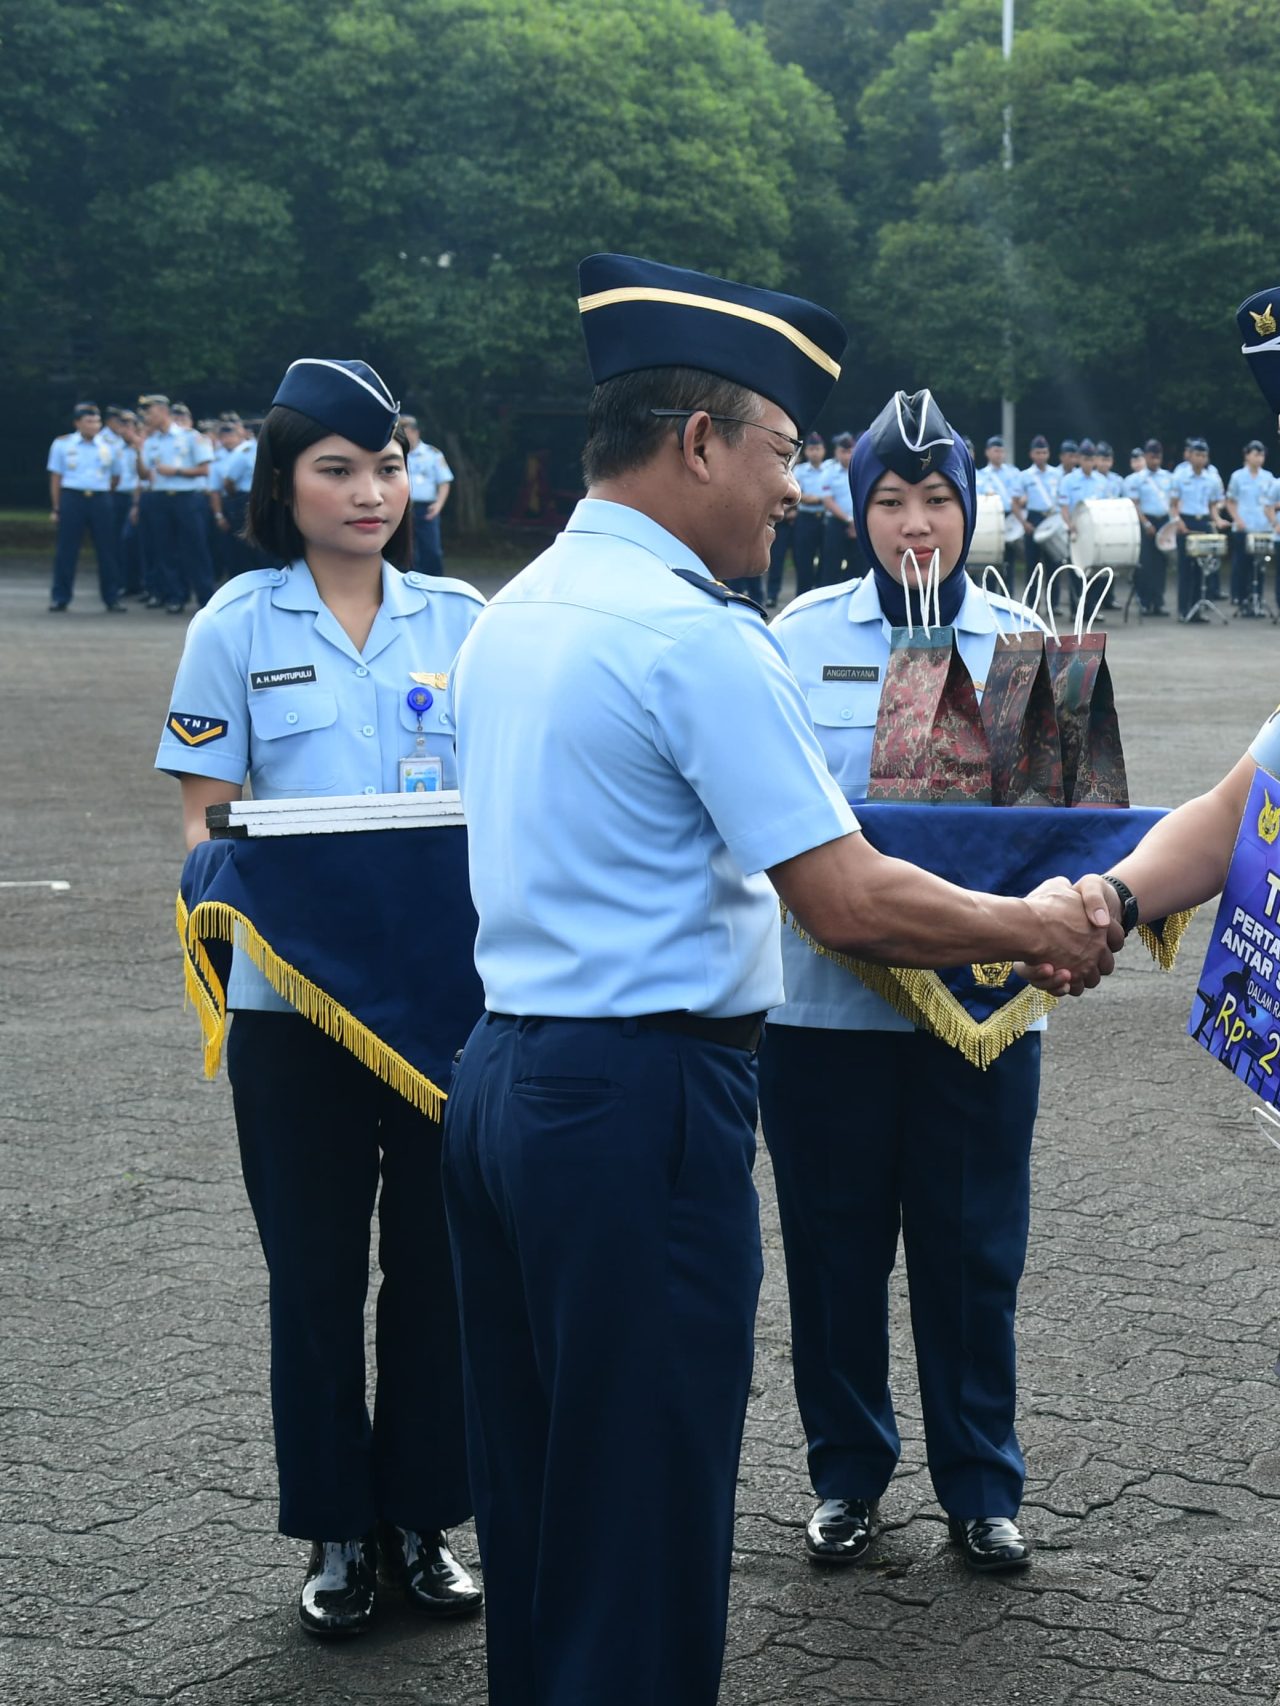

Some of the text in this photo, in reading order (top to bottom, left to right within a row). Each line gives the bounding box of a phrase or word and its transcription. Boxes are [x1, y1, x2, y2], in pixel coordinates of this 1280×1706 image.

[826, 669, 875, 679] ANGGITAYANA
[183, 717, 210, 729] TNI
[1220, 927, 1273, 981] ANTAR
[1247, 980, 1273, 1010] DALAM
[1215, 992, 1252, 1051] Rp.
